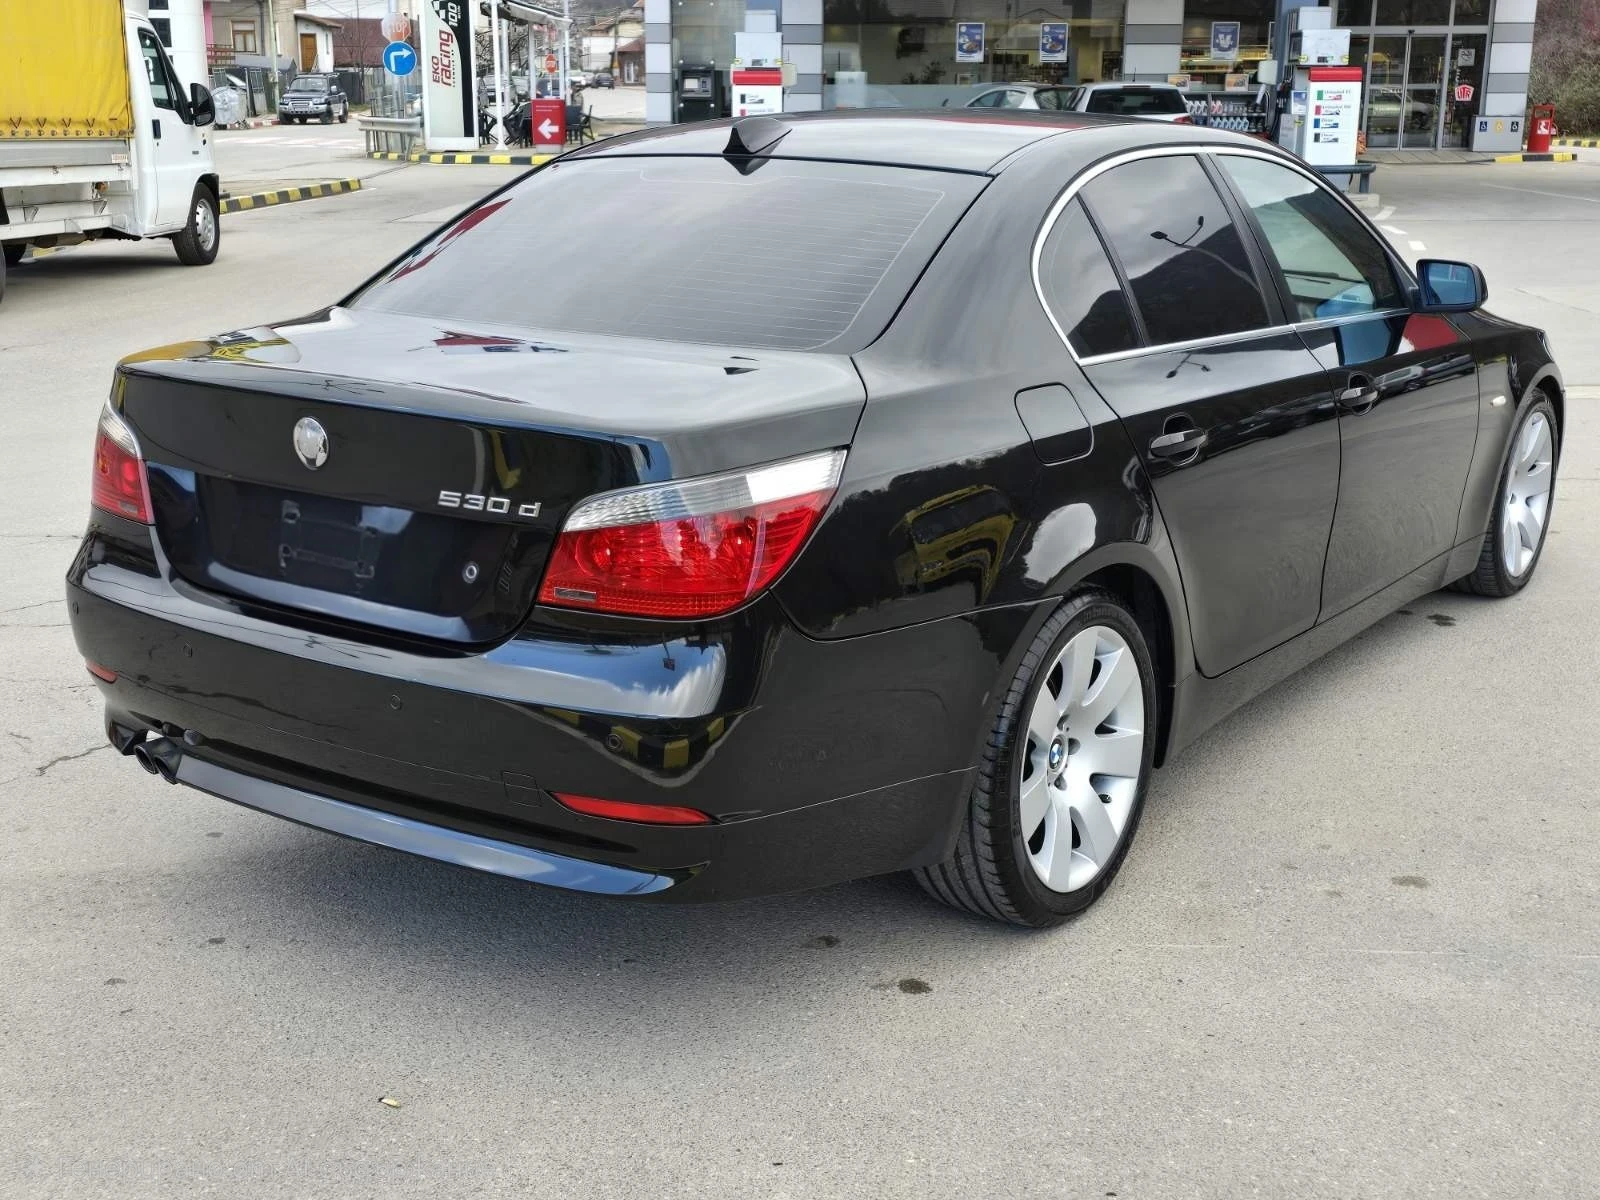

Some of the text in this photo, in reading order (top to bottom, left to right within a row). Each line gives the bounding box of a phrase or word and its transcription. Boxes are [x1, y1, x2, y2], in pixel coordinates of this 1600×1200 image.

[448, 1, 458, 27] 100
[431, 55, 440, 83] EKO
[438, 29, 454, 87] racing
[438, 490, 542, 517] 530 d
